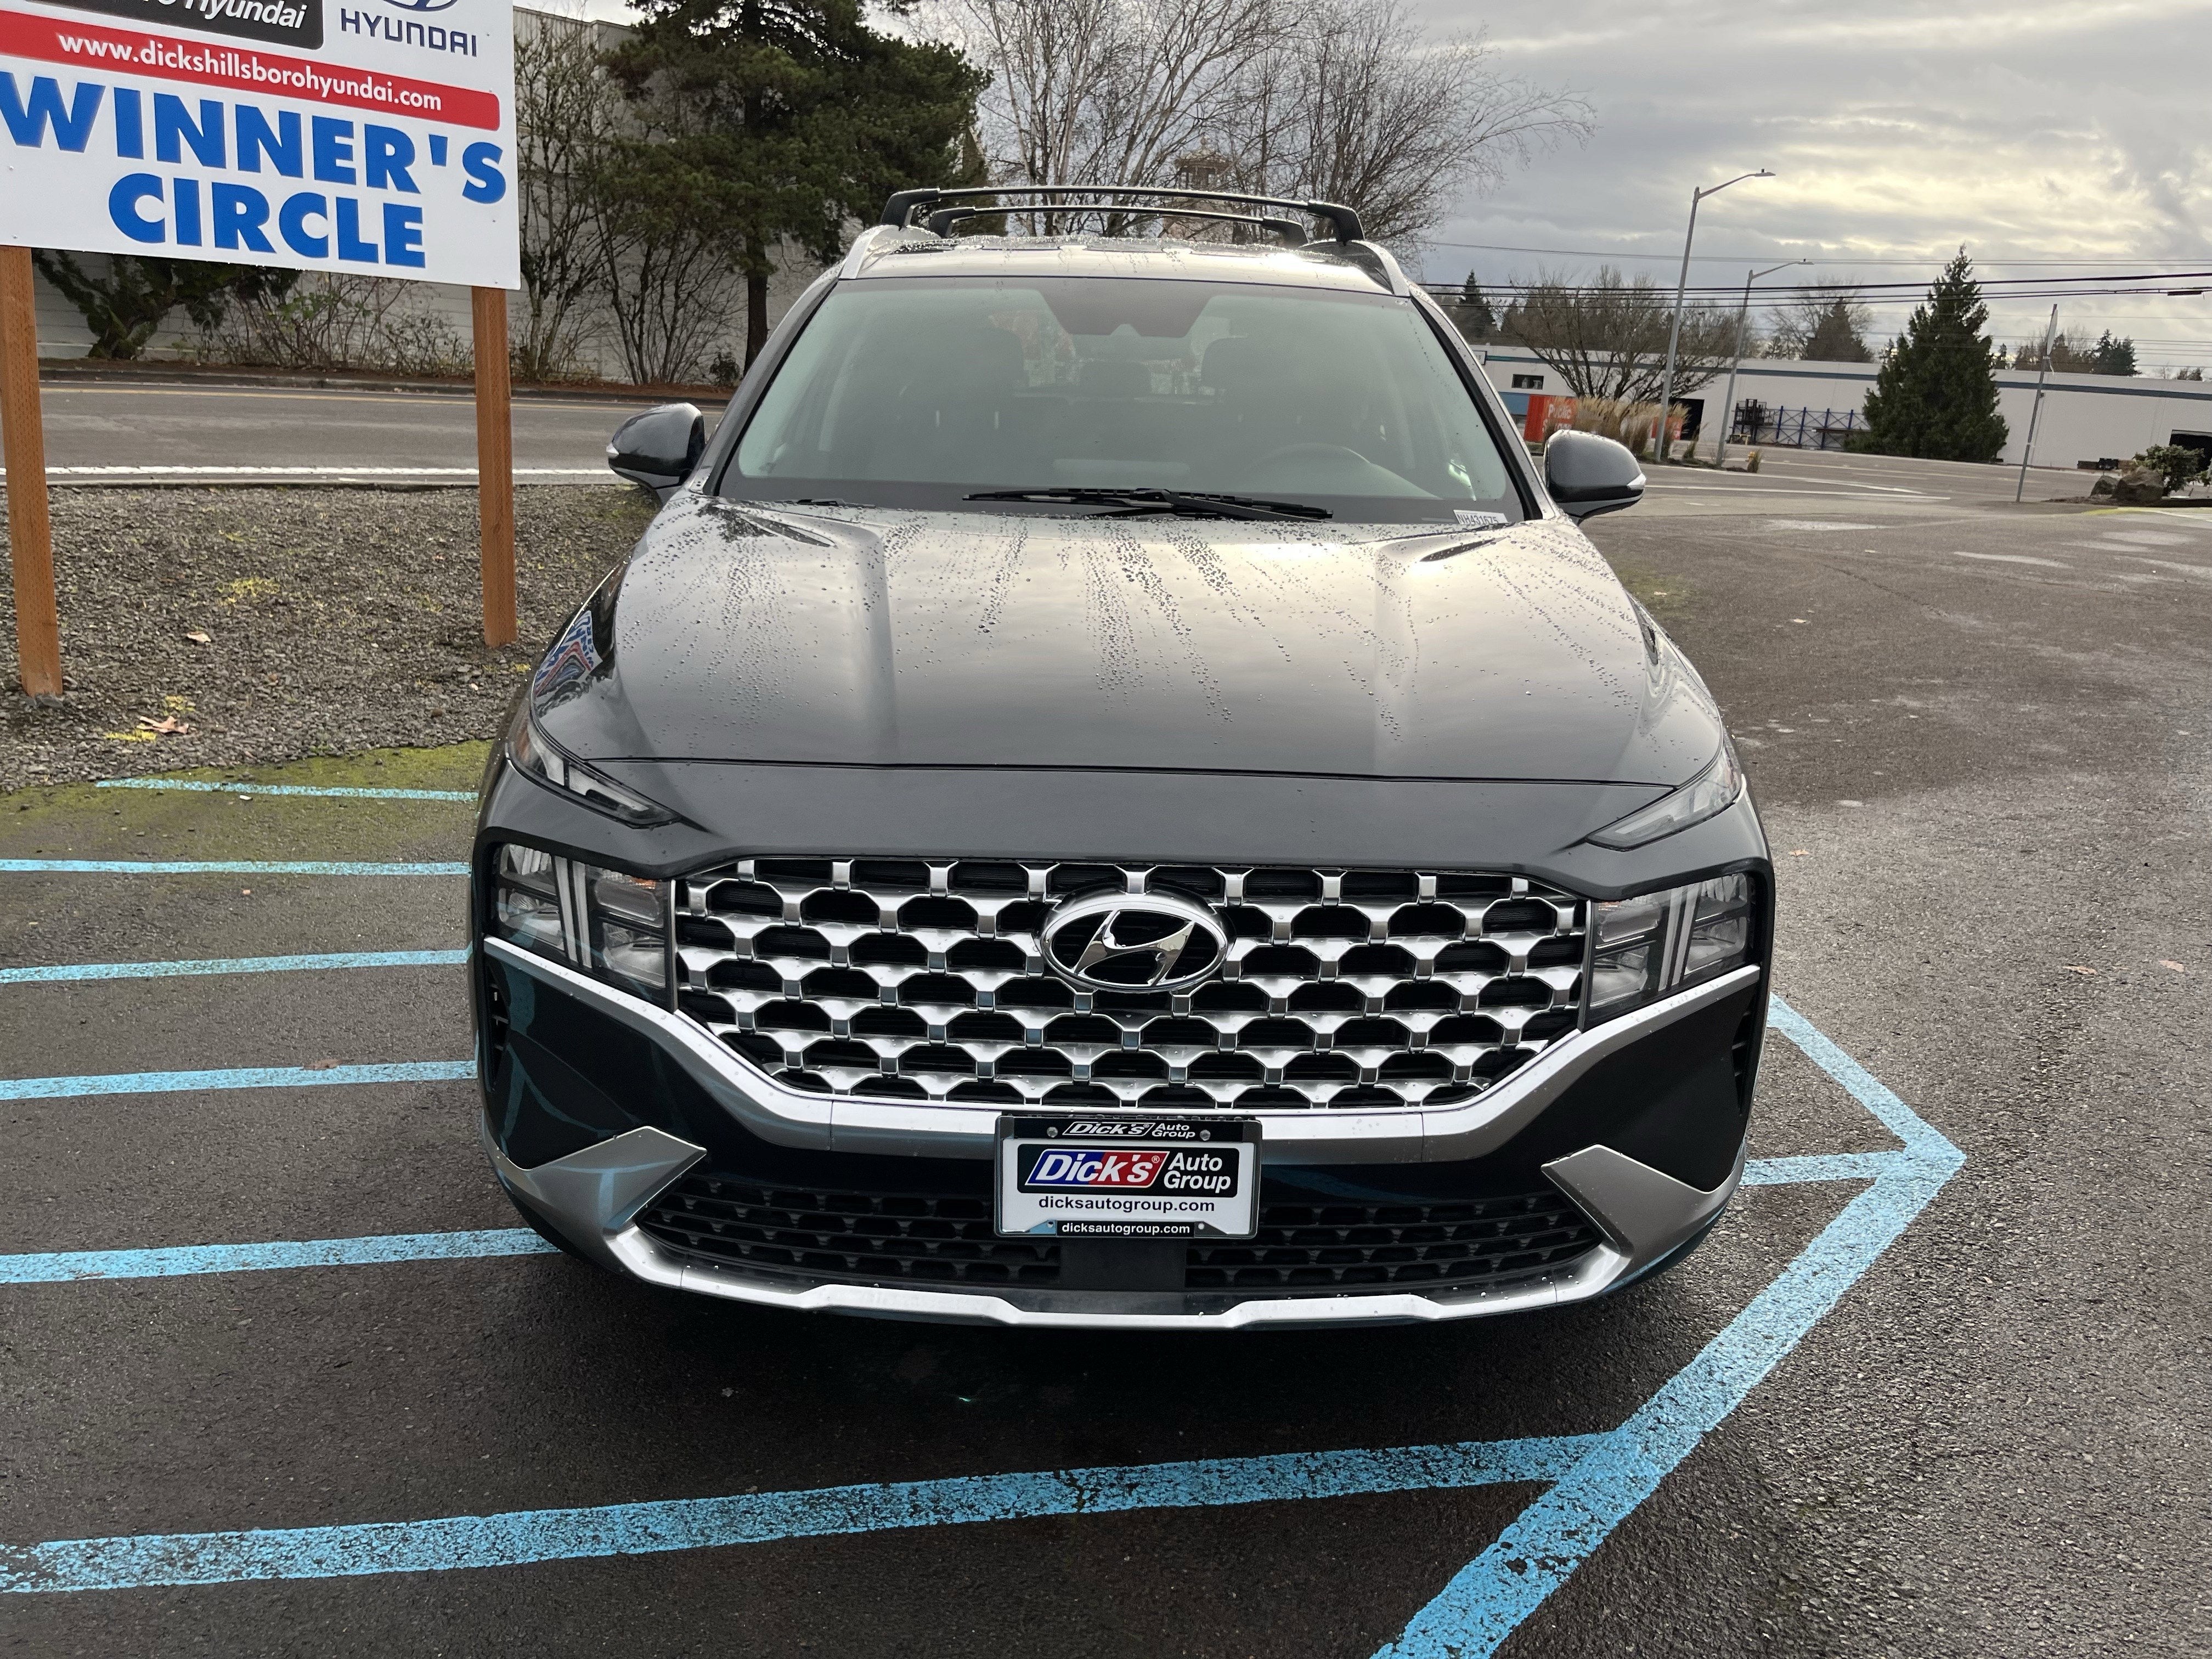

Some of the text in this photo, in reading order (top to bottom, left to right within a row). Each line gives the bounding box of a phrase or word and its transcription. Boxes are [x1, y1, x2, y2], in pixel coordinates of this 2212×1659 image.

[341, 8, 477, 57] HYUNDAI
[57, 33, 442, 111] www.dickshillsborohyundai.com
[0, 71, 507, 205] WINNER'S
[109, 173, 426, 269] CIRCLE
[1152, 1130, 1196, 1139] Group
[1155, 1122, 1190, 1131] Auto
[1035, 1153, 1153, 1183] Dick's
[1167, 1153, 1223, 1172] Auto
[1163, 1171, 1231, 1193] Group
[1039, 1196, 1215, 1213] dicksautogroup.com
[1062, 1223, 1190, 1235] dicksautogroup.com
